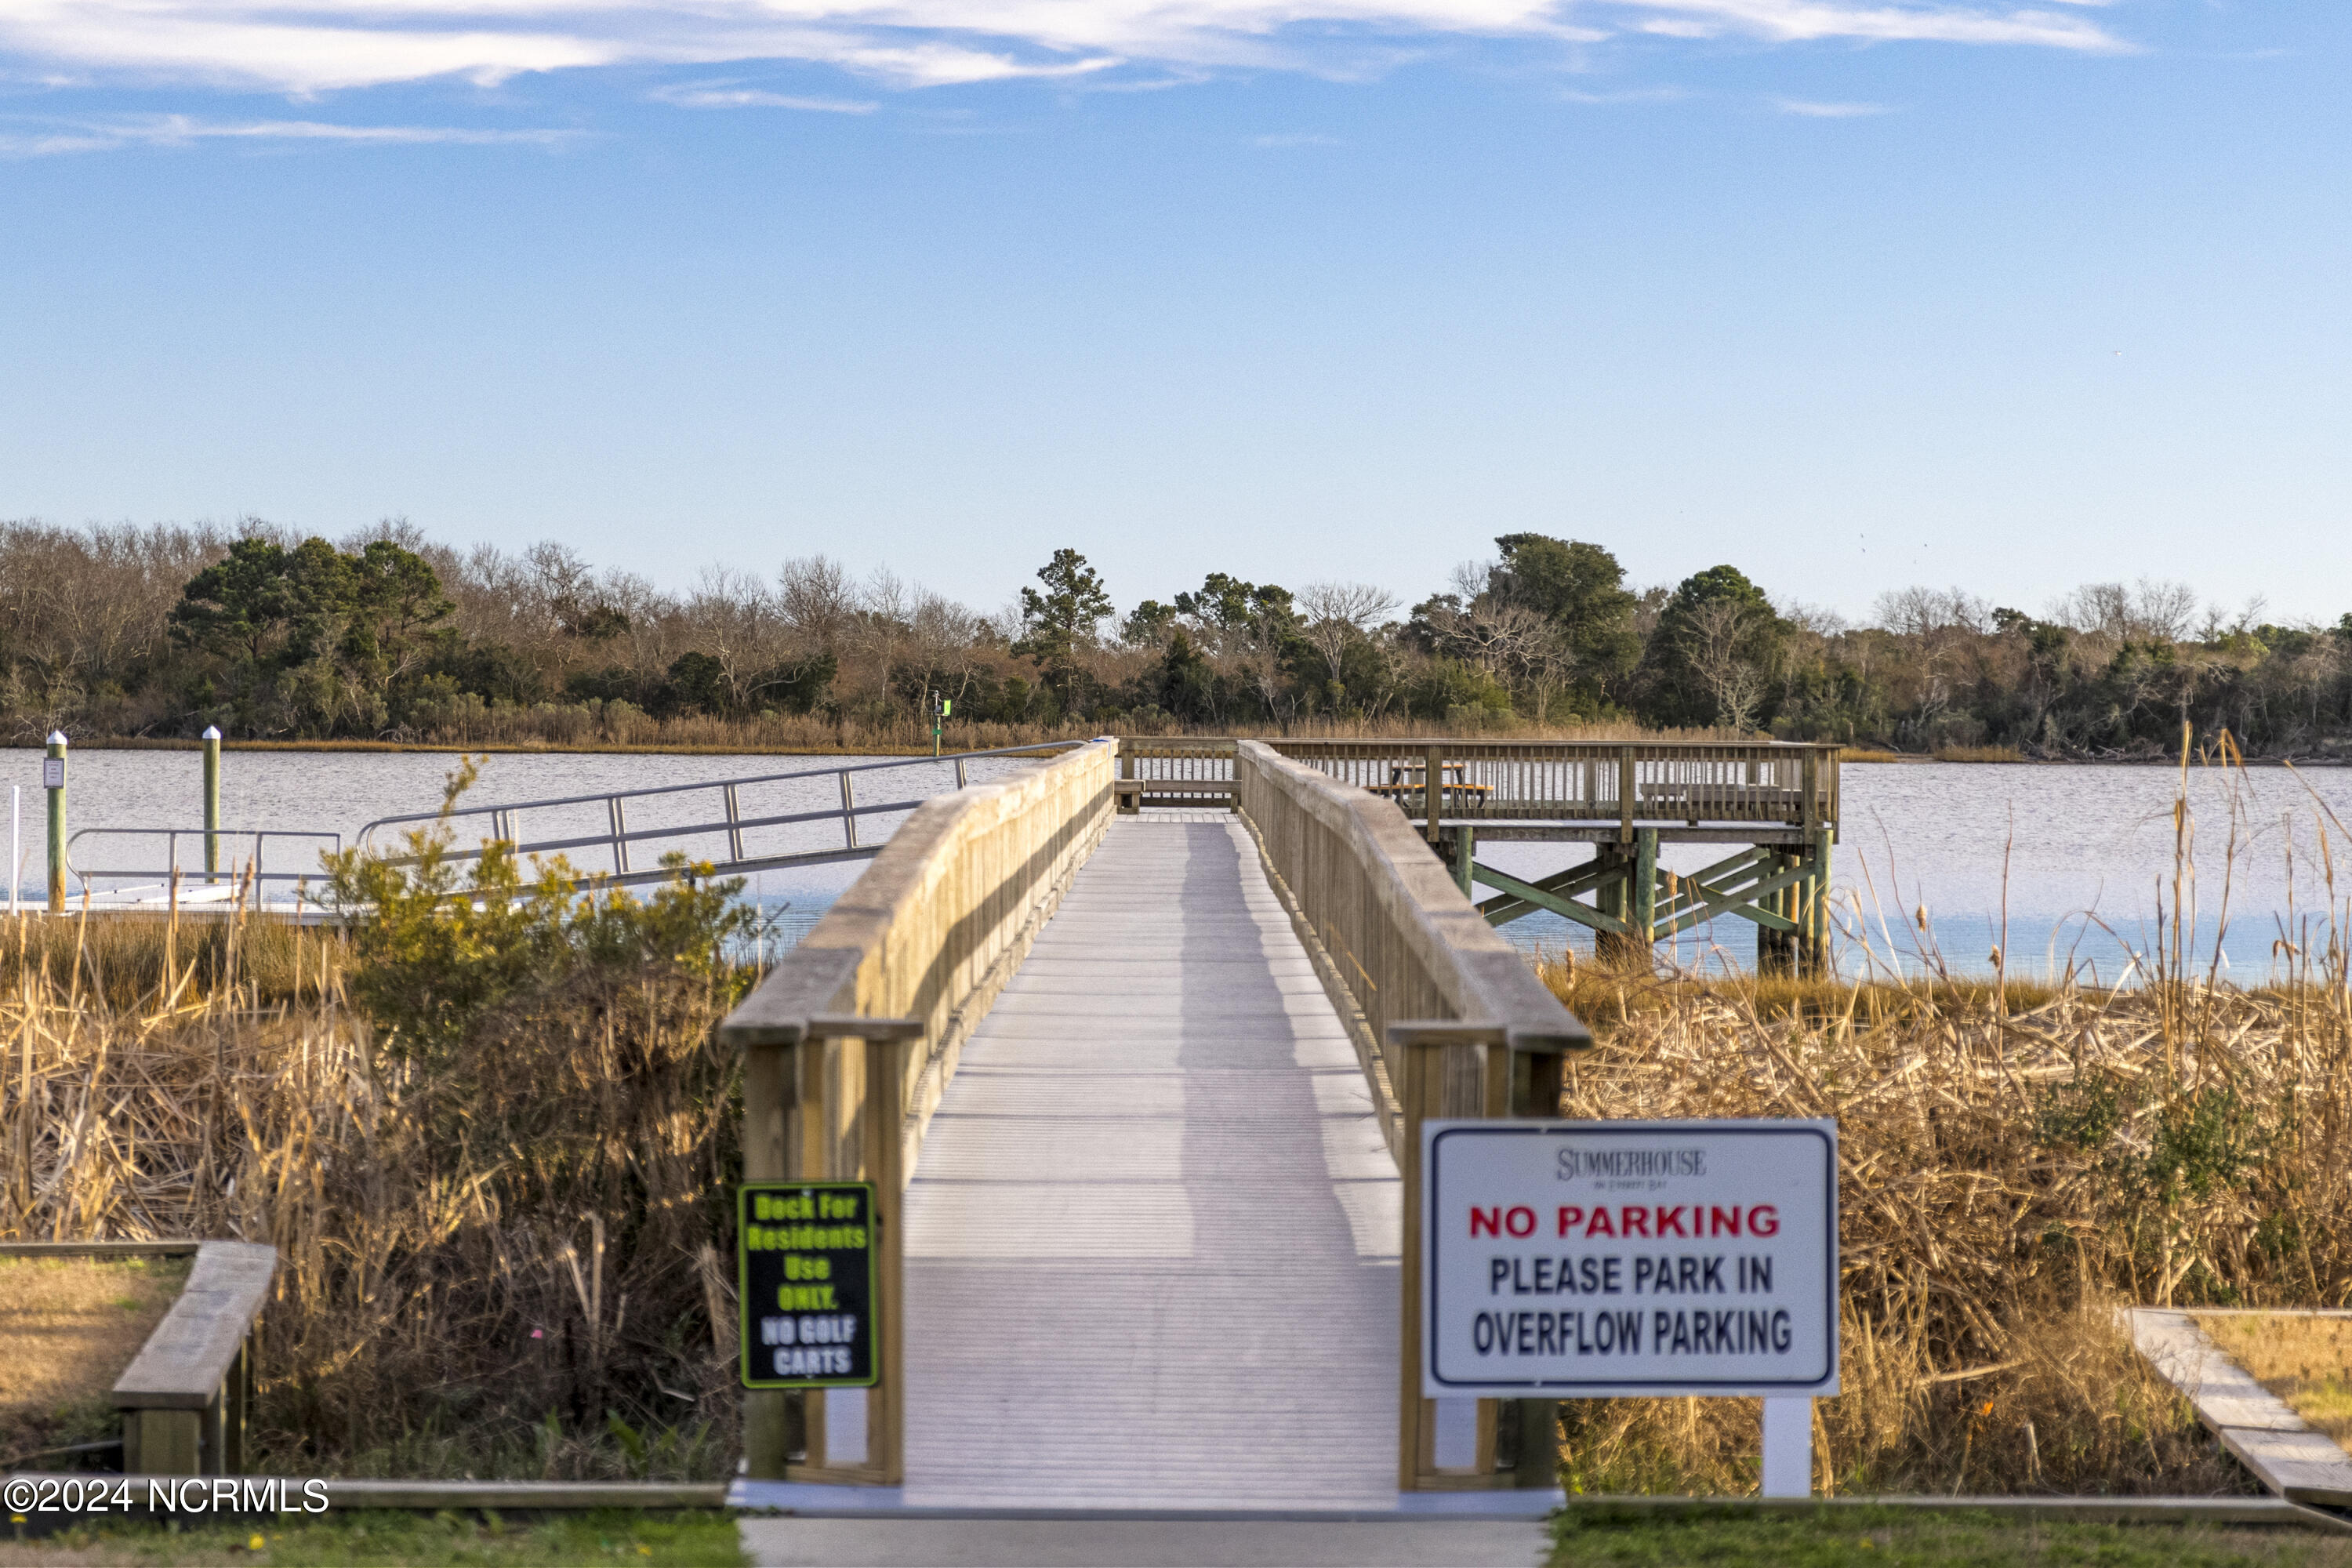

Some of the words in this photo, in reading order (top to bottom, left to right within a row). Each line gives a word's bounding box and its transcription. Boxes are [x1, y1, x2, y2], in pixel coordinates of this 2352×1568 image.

[1556, 1148, 1707, 1181] SUMMERHOUSE
[755, 1195, 814, 1220] Dock
[819, 1195, 857, 1218] For
[1469, 1206, 1538, 1239] NO
[1557, 1205, 1780, 1239] PARKING
[748, 1225, 866, 1250] Residents
[785, 1255, 829, 1279] Use
[1490, 1258, 1622, 1294] PLEASE
[1635, 1257, 1726, 1294] PARK
[1739, 1256, 1773, 1293] IN
[760, 1316, 796, 1345] NO
[797, 1314, 857, 1344] GOLF
[1474, 1312, 1643, 1355] OVERFLOW
[1654, 1310, 1792, 1355] PARKING
[773, 1346, 852, 1375] CARTS
